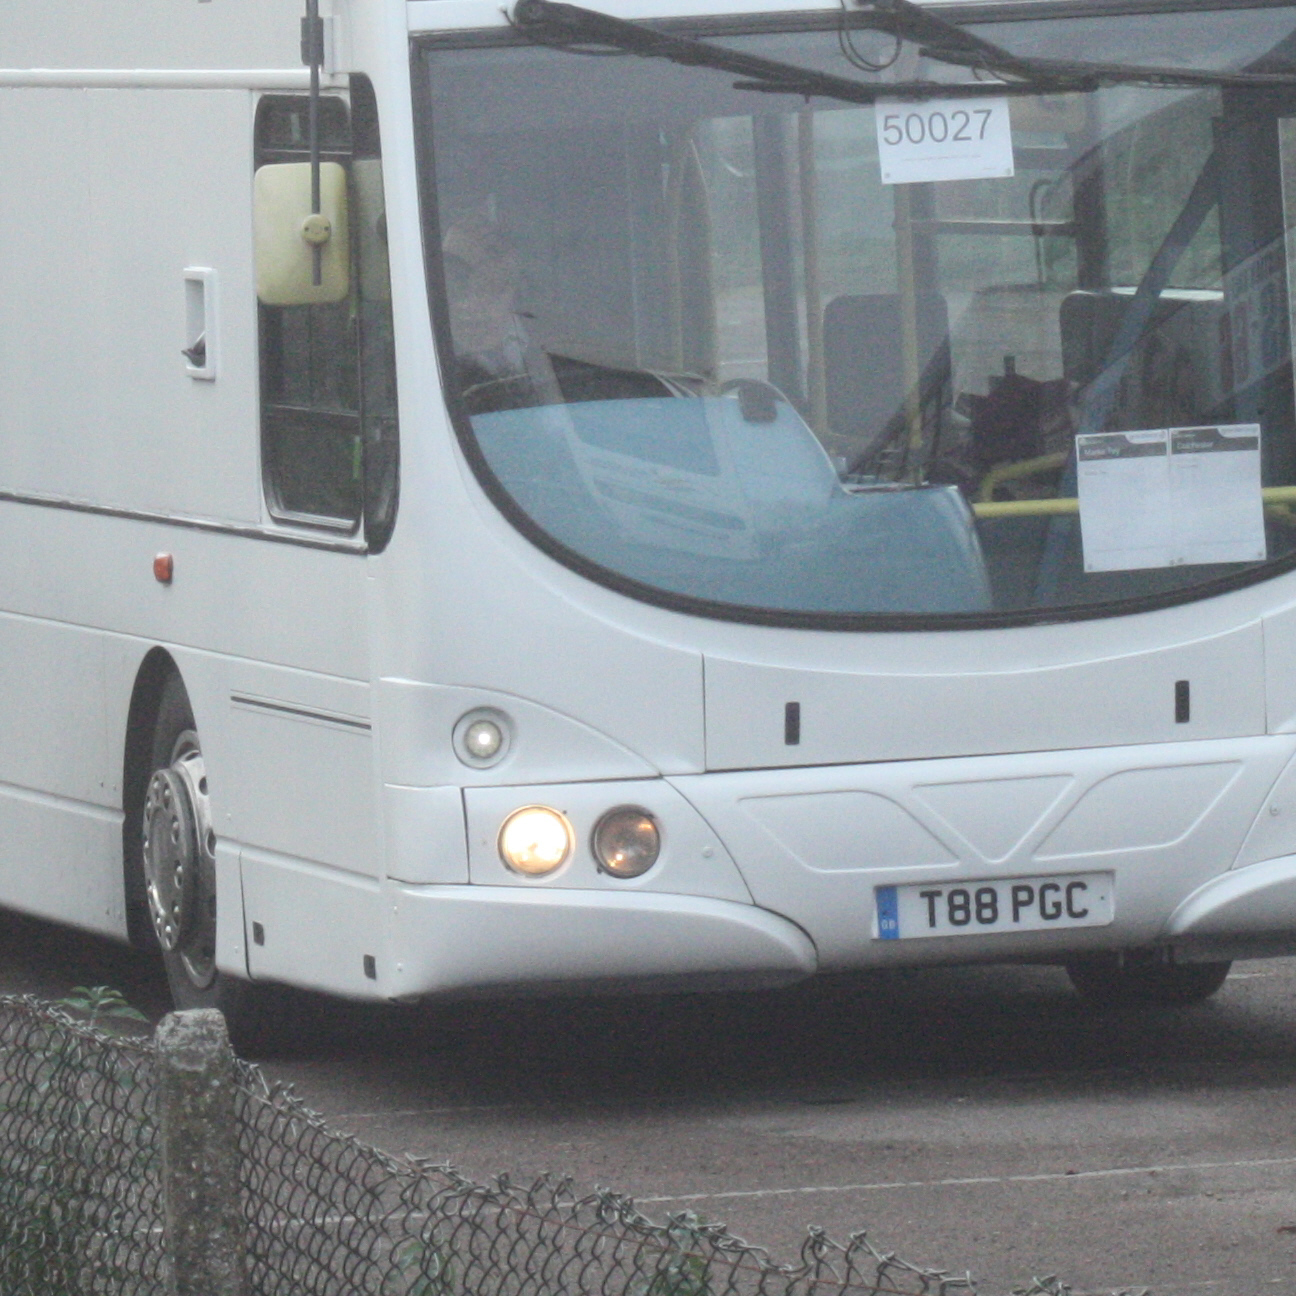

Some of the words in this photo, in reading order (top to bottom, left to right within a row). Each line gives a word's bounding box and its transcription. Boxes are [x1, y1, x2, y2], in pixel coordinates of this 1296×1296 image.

[883, 109, 993, 145] 50027
[919, 888, 998, 928] T88
[1011, 881, 1089, 923] PGC
